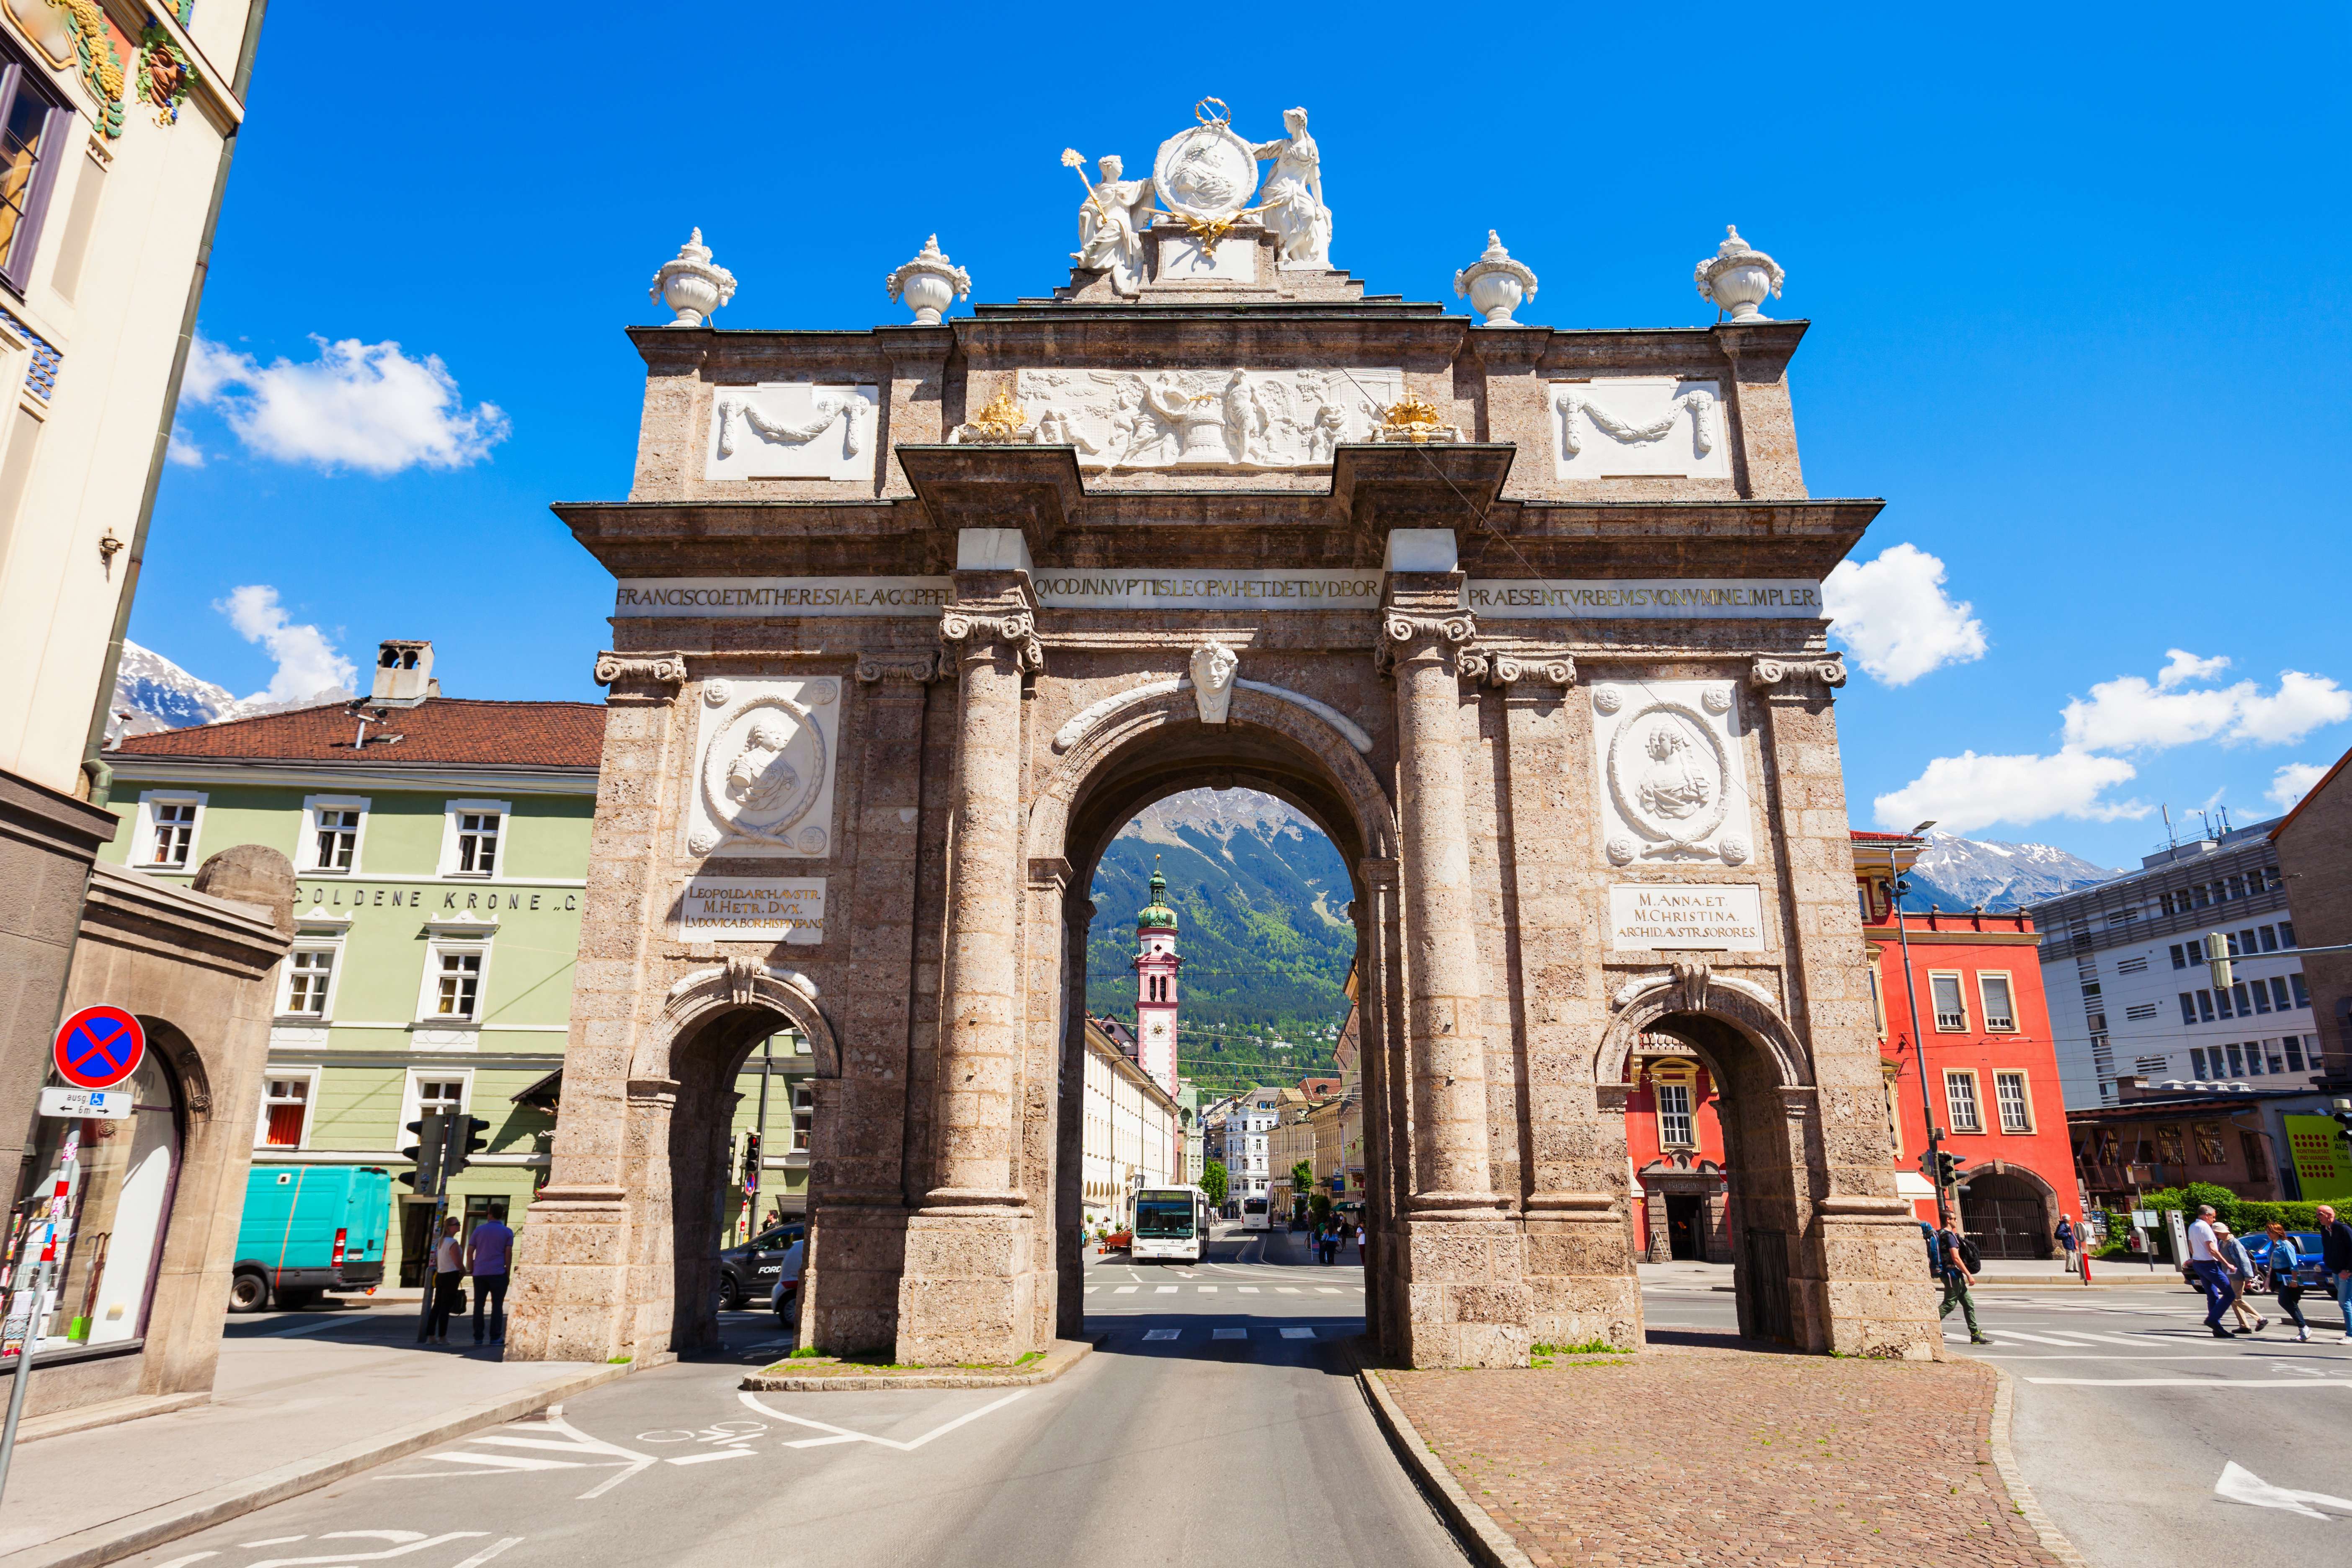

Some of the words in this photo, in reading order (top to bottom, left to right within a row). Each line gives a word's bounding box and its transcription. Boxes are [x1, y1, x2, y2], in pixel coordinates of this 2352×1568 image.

[293, 887, 421, 908] GOLDENE
[444, 892, 541, 910] KRONE
[758, 1266, 781, 1274] FORD
